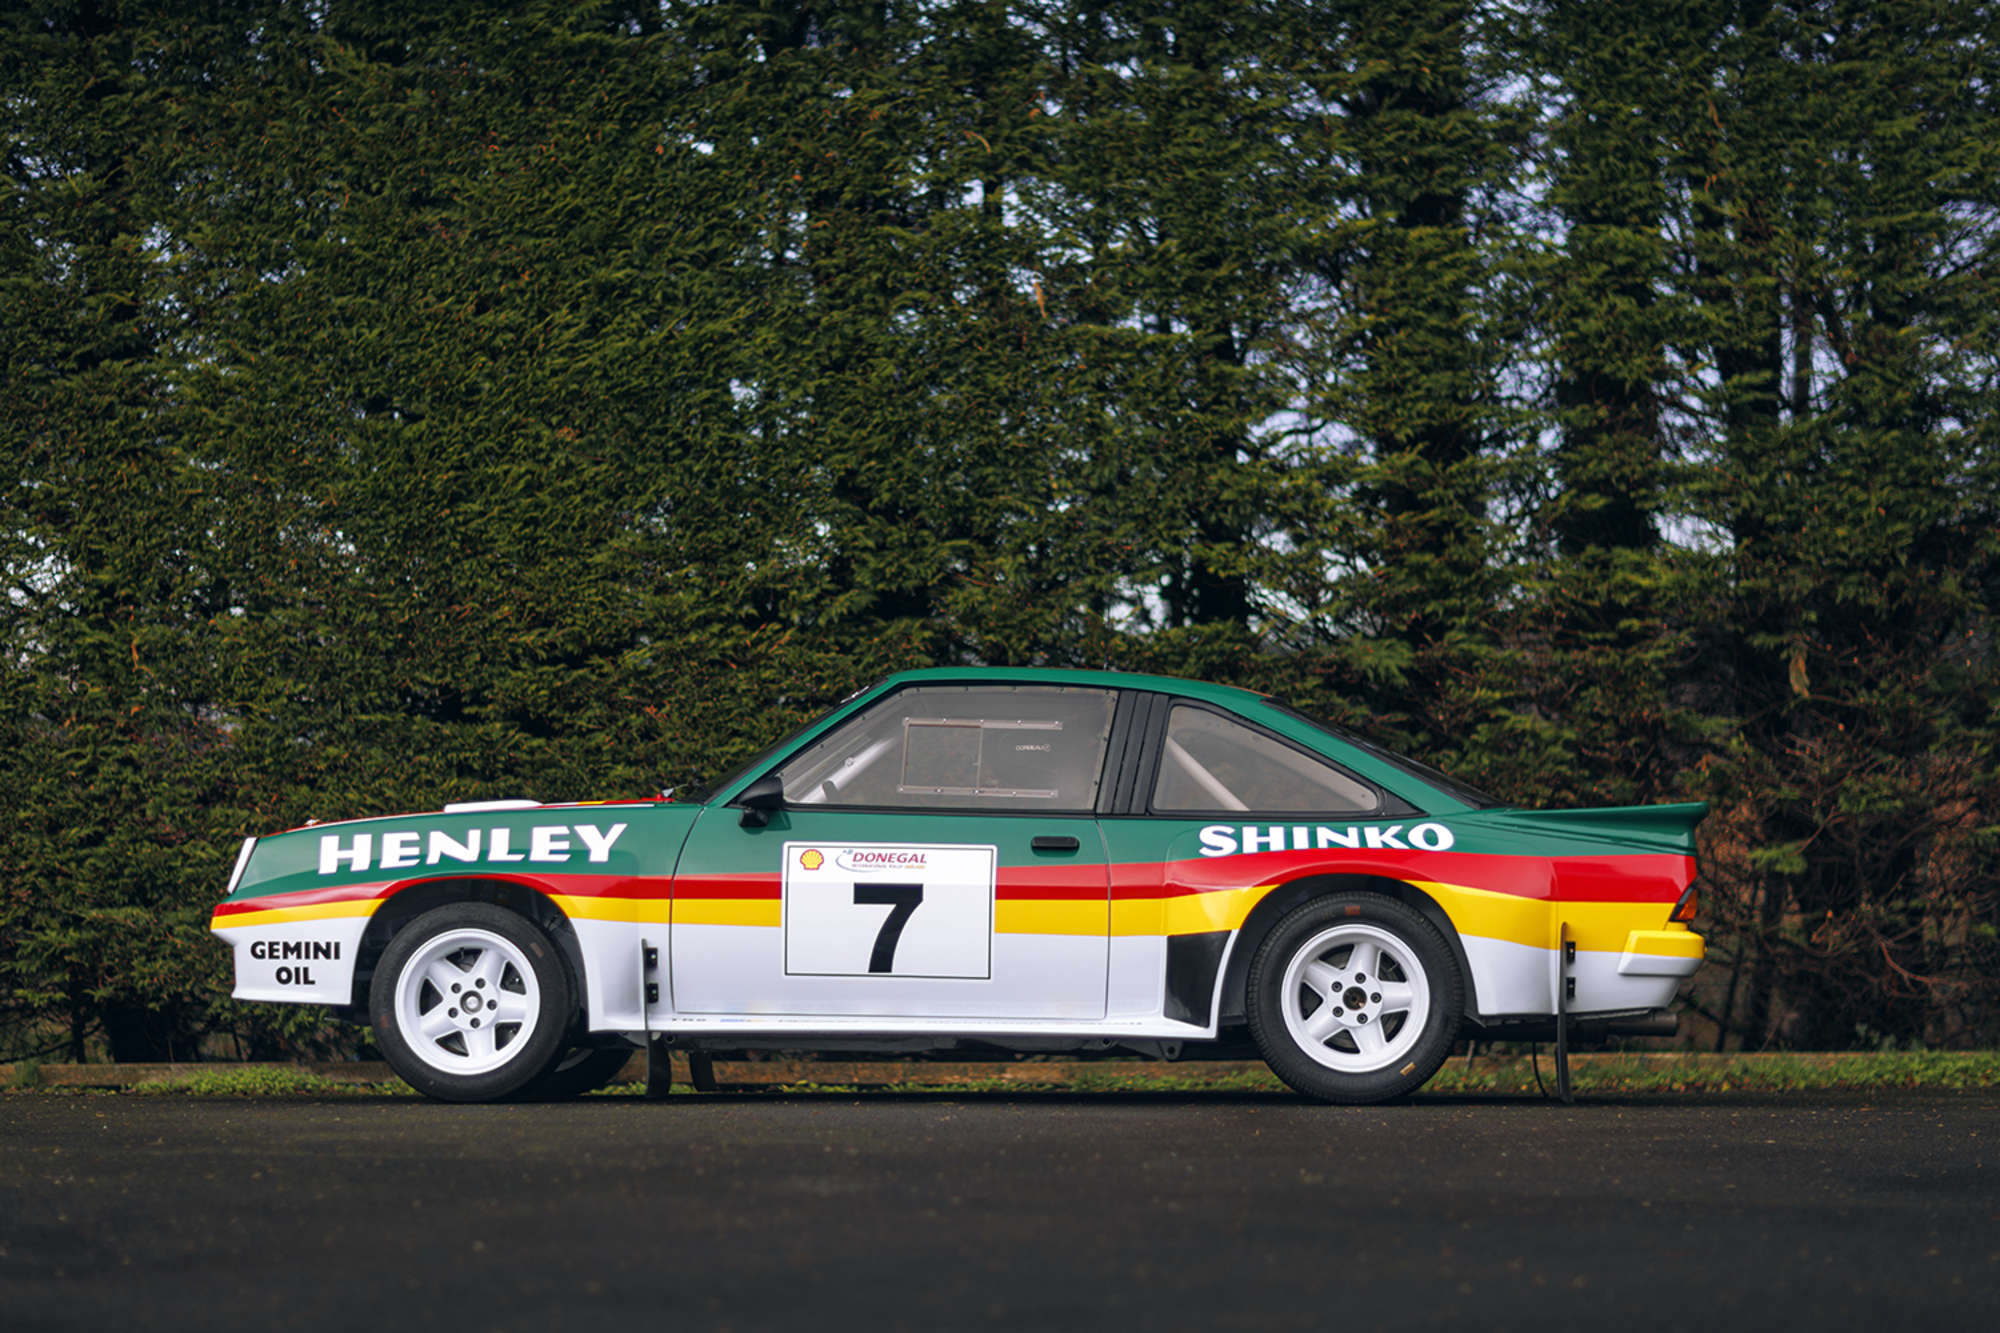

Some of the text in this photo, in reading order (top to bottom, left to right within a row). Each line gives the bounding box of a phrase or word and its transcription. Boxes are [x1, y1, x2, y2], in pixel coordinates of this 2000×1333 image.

[318, 823, 628, 874] HENLEY
[1198, 822, 1455, 857] SHINKO
[852, 852, 927, 863] DONEGAL
[853, 882, 923, 973] 7
[250, 940, 341, 960] GEMINI
[275, 966, 316, 985] OIL
